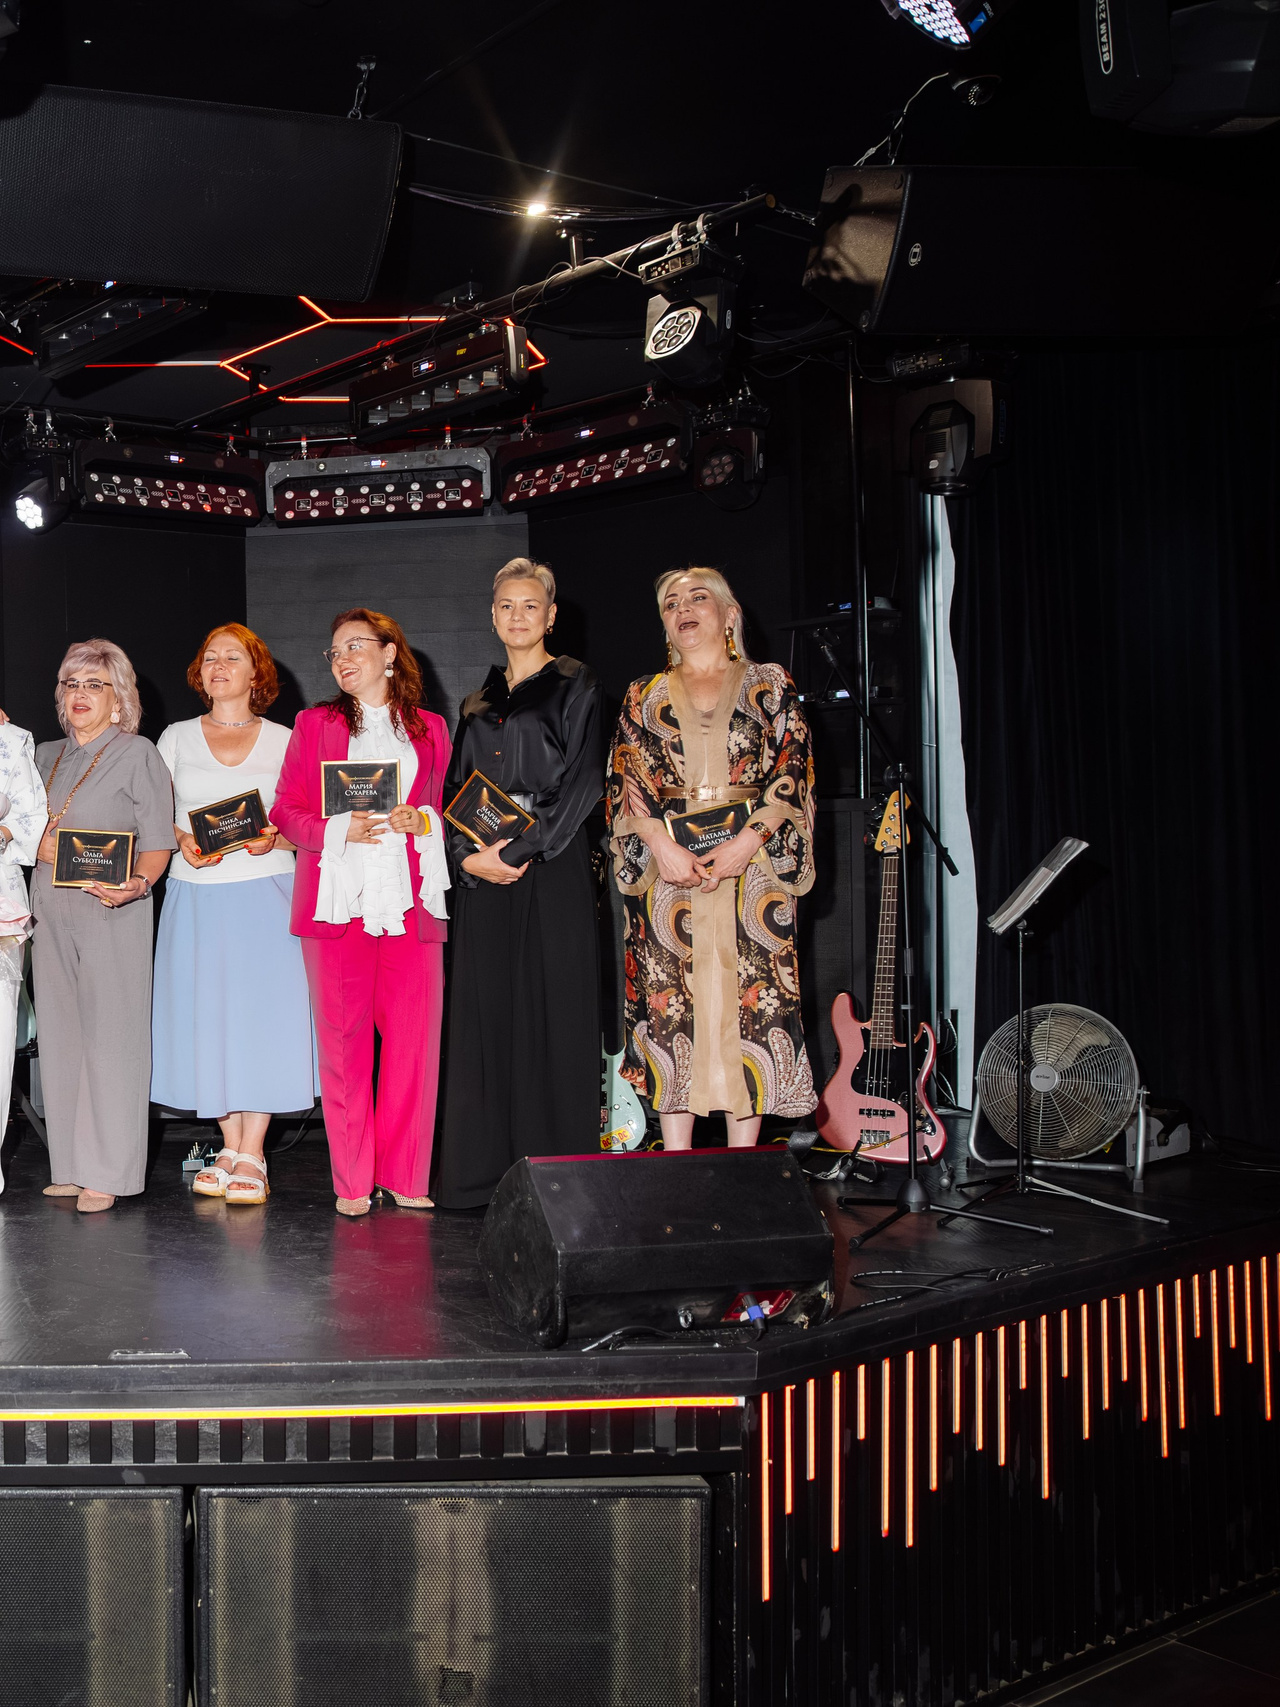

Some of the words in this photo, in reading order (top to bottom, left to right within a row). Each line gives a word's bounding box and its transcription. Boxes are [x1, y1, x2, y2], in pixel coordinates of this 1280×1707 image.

[1100, 22, 1111, 62] BEAM
[219, 817, 239, 827] НИКА
[476, 808, 499, 831] САВИНА
[480, 805, 501, 825] МАРИЯ
[688, 834, 738, 850] САМОЛОВСК
[698, 828, 731, 842] НАТАЛЬЯ
[72, 856, 113, 865] СУББОТИНА
[82, 850, 104, 858] ОЛЬГА
